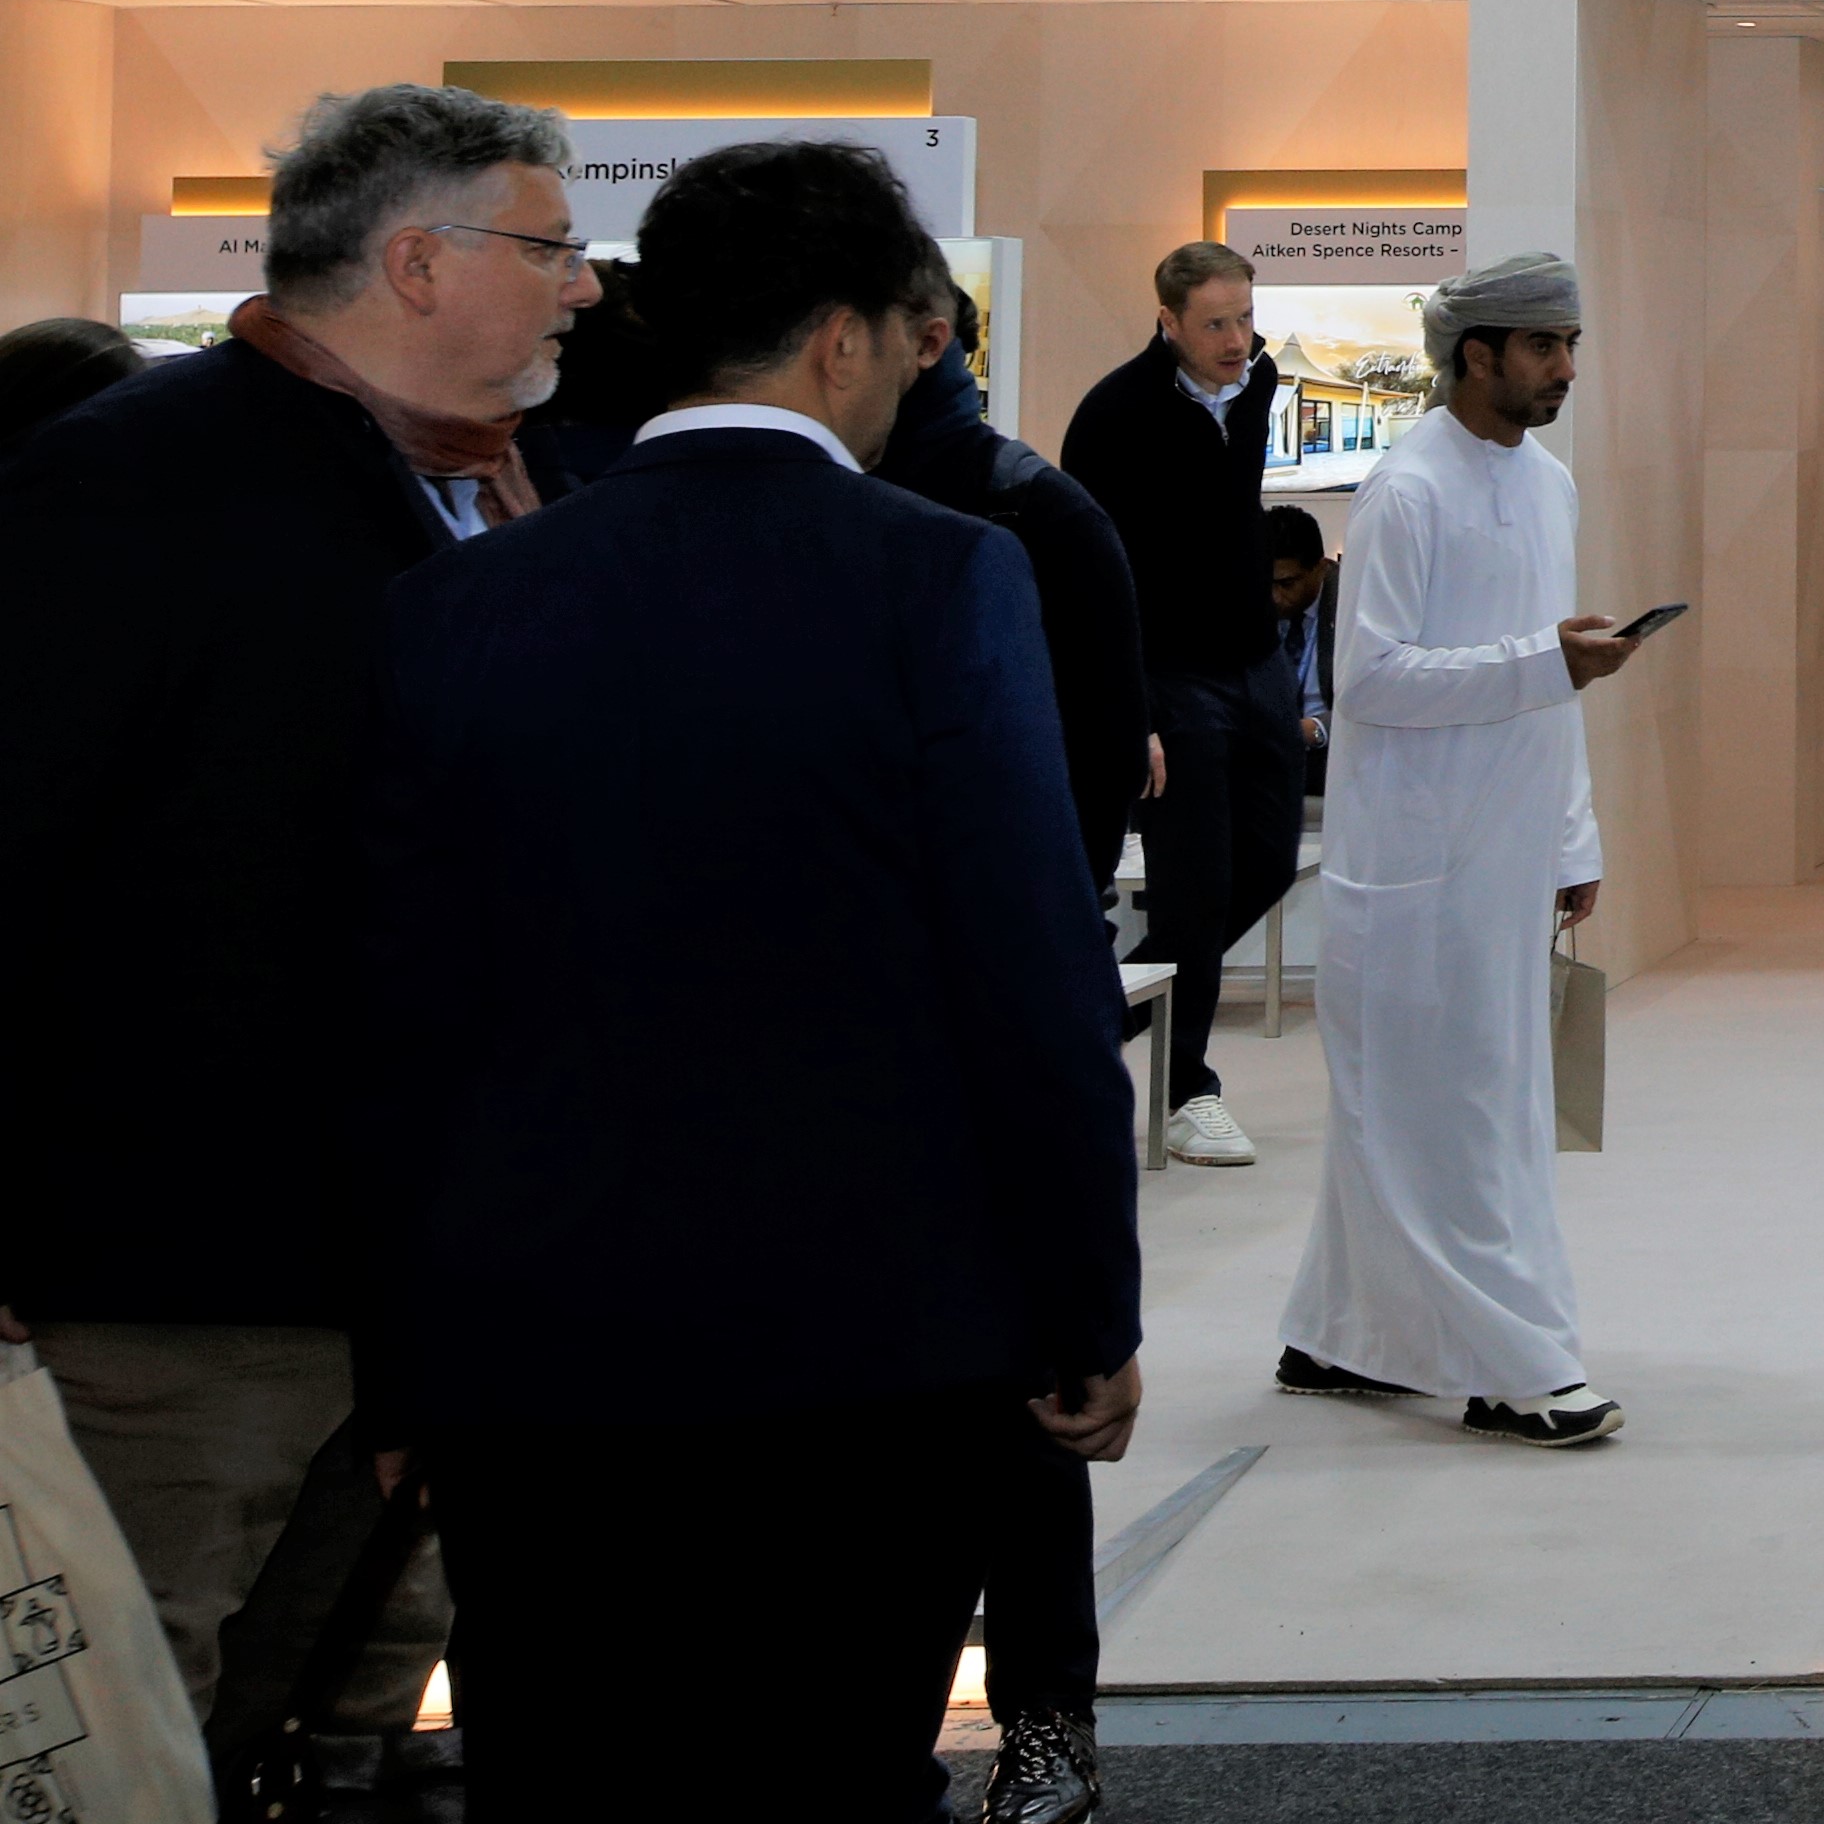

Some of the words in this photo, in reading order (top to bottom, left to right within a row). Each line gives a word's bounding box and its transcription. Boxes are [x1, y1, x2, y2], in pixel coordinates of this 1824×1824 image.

[925, 129, 939, 147] 3
[1290, 222, 1346, 236] Desert
[1352, 221, 1407, 238] Nights
[1412, 221, 1462, 237] Camp
[219, 239, 237, 253] Al
[1252, 243, 1306, 257] Aitken
[1312, 243, 1374, 260] Spence
[1380, 243, 1444, 257] Resorts
